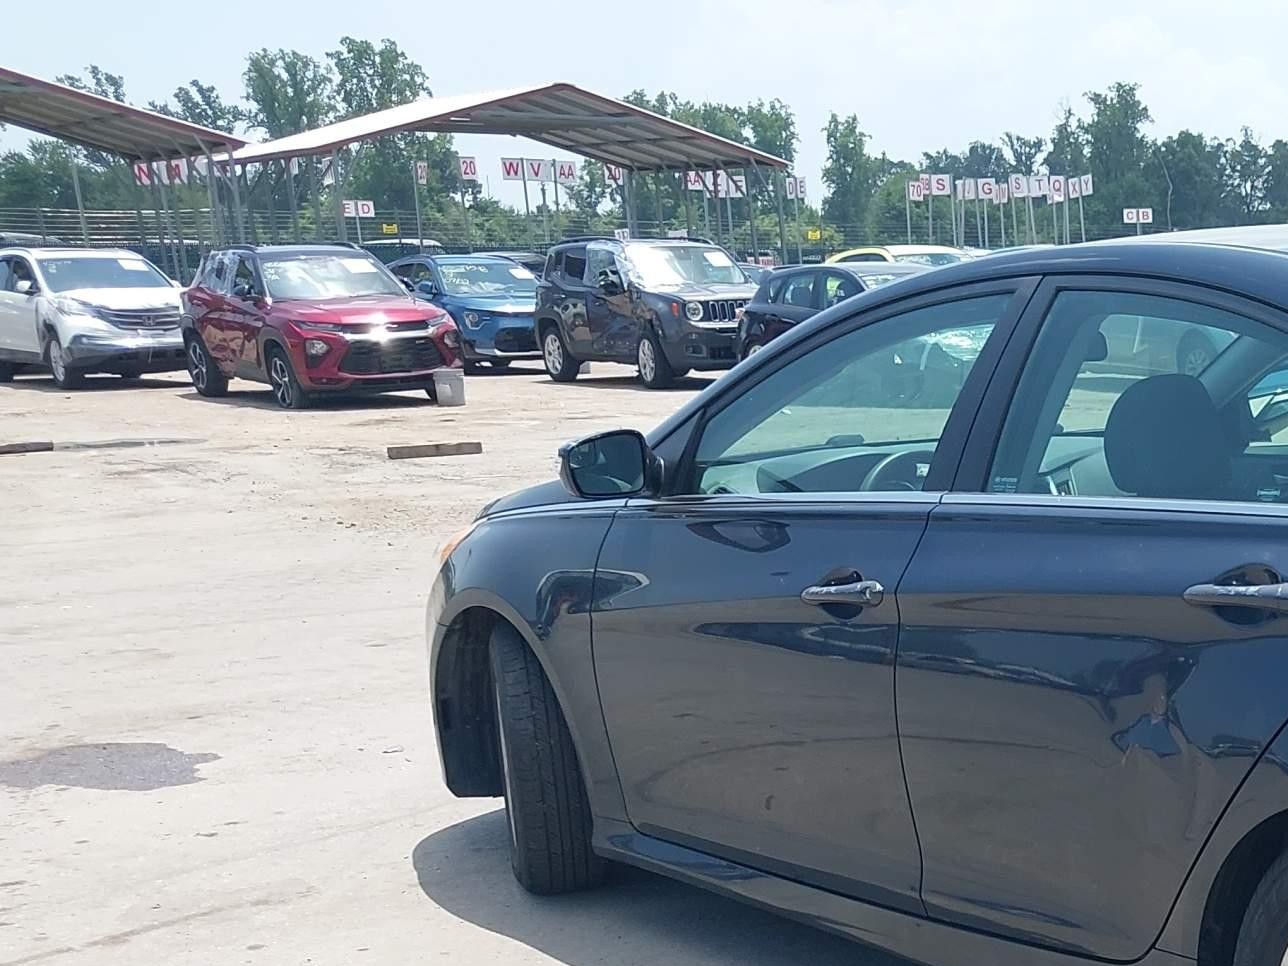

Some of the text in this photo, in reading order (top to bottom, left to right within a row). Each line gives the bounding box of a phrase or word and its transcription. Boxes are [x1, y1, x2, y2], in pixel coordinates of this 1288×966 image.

[462, 160, 476, 176] 20
[503, 161, 520, 177] W
[530, 162, 542, 178] V
[559, 164, 576, 180] AA
[799, 180, 806, 194] E
[910, 184, 922, 198] 70
[936, 178, 946, 191] S
[982, 182, 993, 195] G
[1014, 177, 1021, 191] S
[1035, 178, 1044, 192] T
[1052, 179, 1062, 192] Q
[1070, 181, 1078, 196] X
[1082, 177, 1090, 191] Y
[361, 203, 371, 215] D
[1126, 211, 1150, 221] C B
